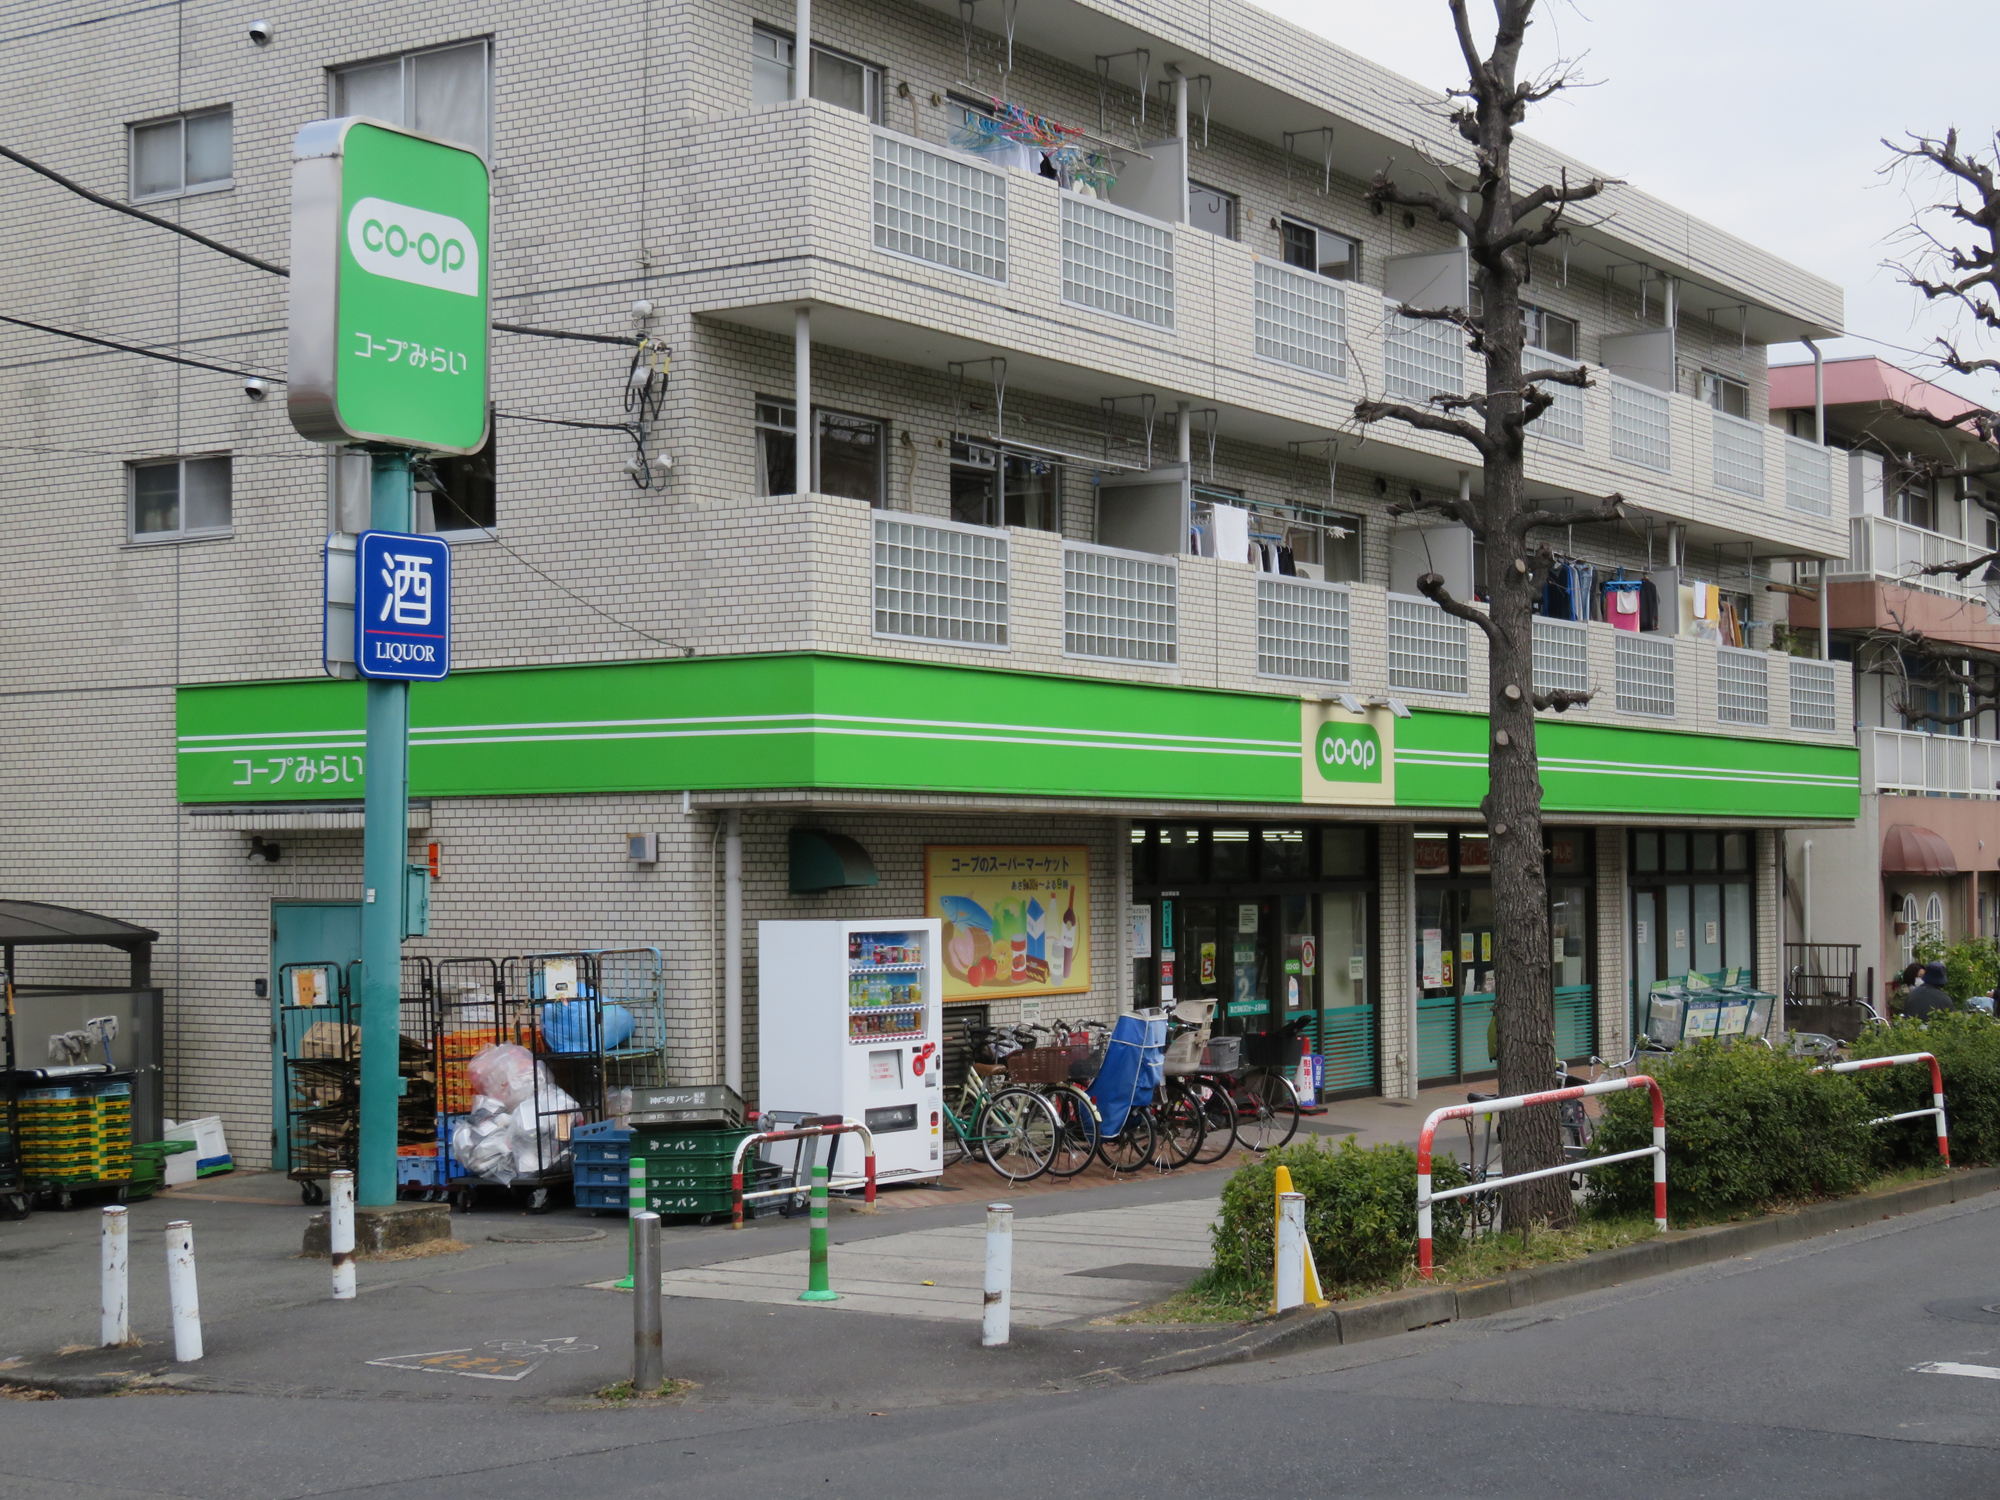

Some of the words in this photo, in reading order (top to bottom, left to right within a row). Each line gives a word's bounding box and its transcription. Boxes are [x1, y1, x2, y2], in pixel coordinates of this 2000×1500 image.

[355, 332, 467, 375] コープみらい
[380, 551, 433, 625] 酒
[375, 641, 436, 663] LIQUOR
[233, 755, 363, 785] コープみらい
[951, 855, 1069, 873] コープのスーパーマーケット
[650, 1095, 693, 1105] 神戸屋パン
